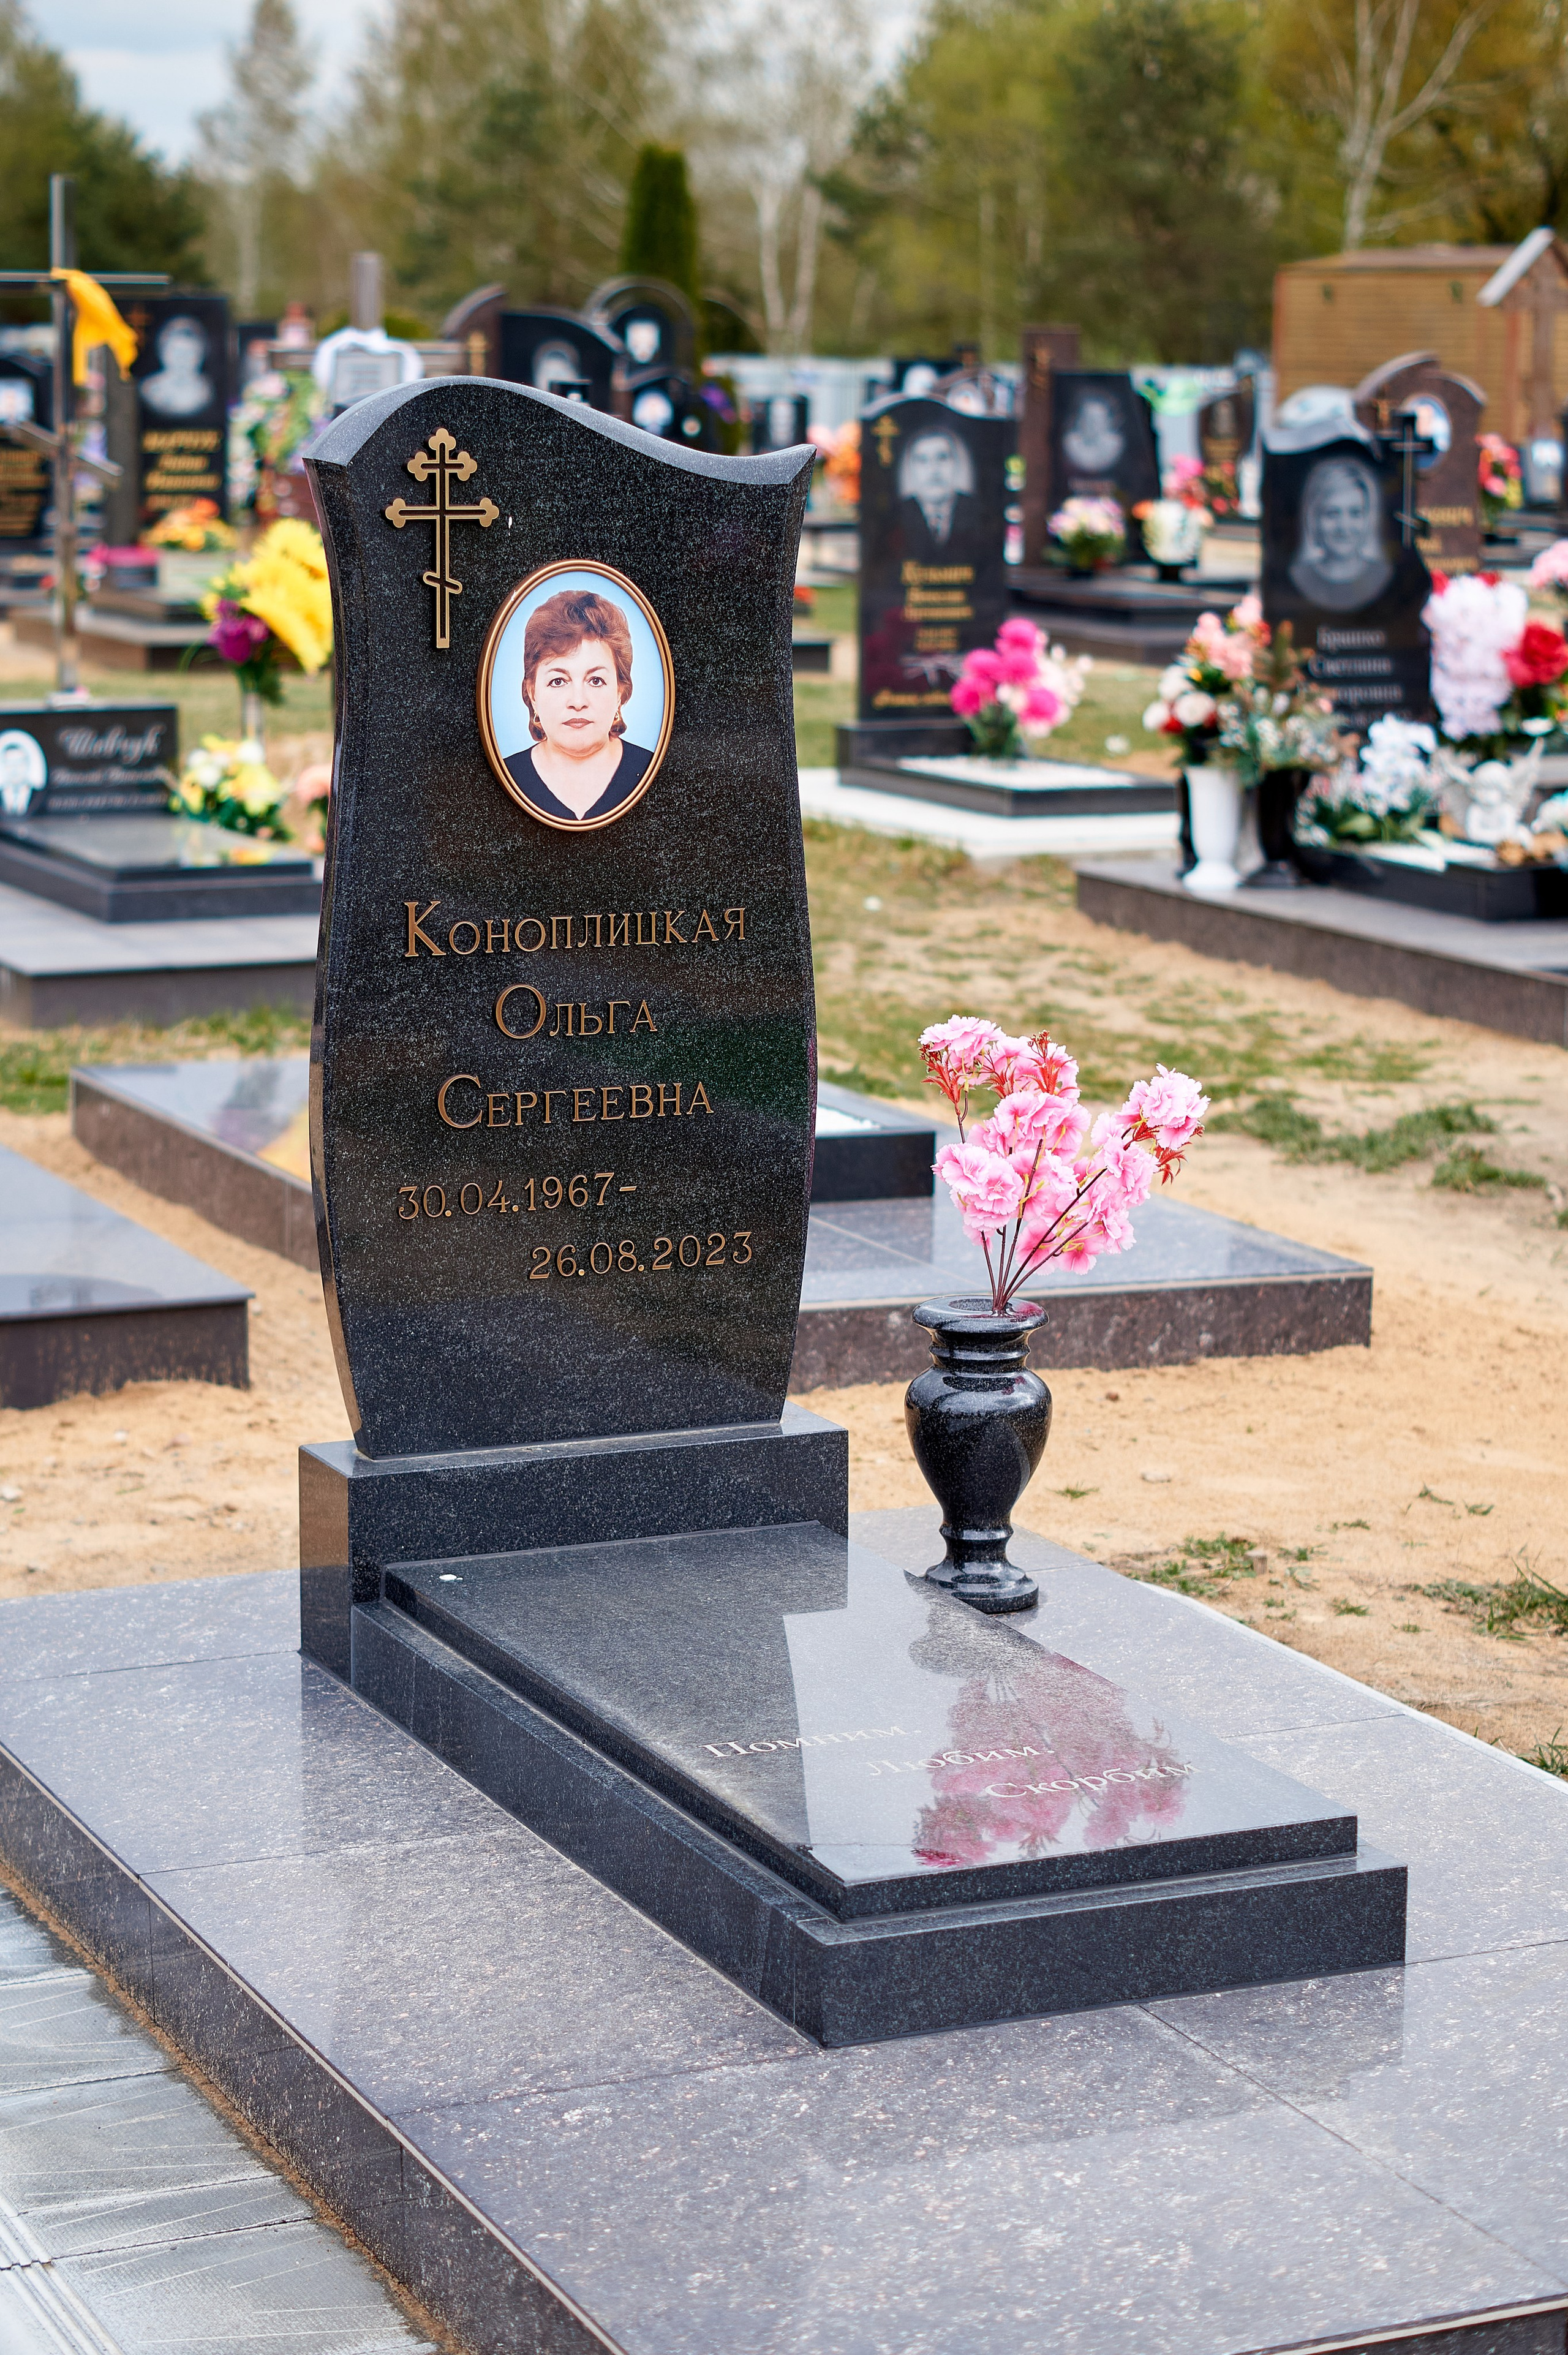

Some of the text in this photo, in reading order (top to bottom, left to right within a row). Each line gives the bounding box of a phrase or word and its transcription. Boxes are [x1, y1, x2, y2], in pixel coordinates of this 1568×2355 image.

[398, 1172, 637, 1220] 30.04.1967-
[529, 1231, 752, 1280] 26.08.2023
[869, 1744, 1056, 1776] Любим.
